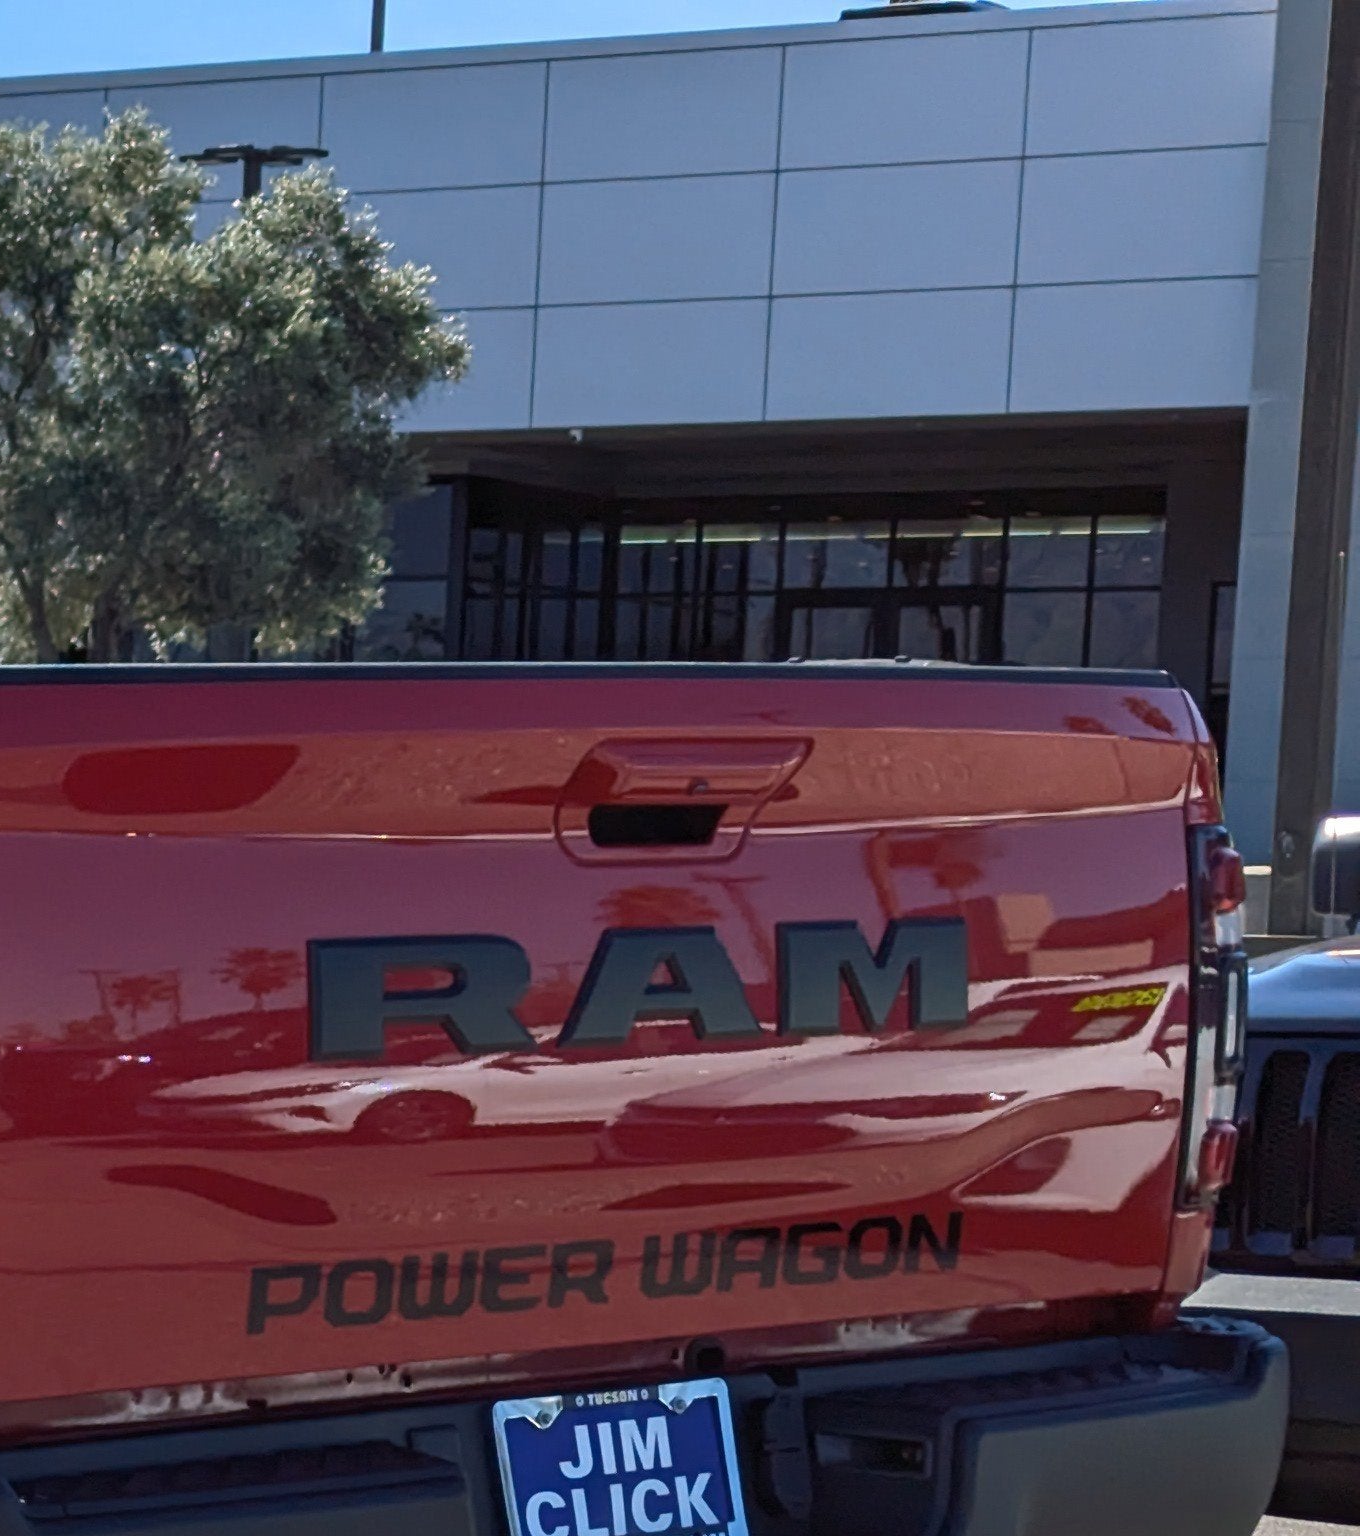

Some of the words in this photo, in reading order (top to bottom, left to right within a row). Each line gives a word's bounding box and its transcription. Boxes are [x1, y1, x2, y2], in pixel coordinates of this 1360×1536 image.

[306, 917, 970, 1061] RAM
[246, 1238, 614, 1336] POWER
[640, 1211, 964, 1299] WAGON
[586, 1389, 639, 1406] TUCSON
[558, 1415, 673, 1479] JIM
